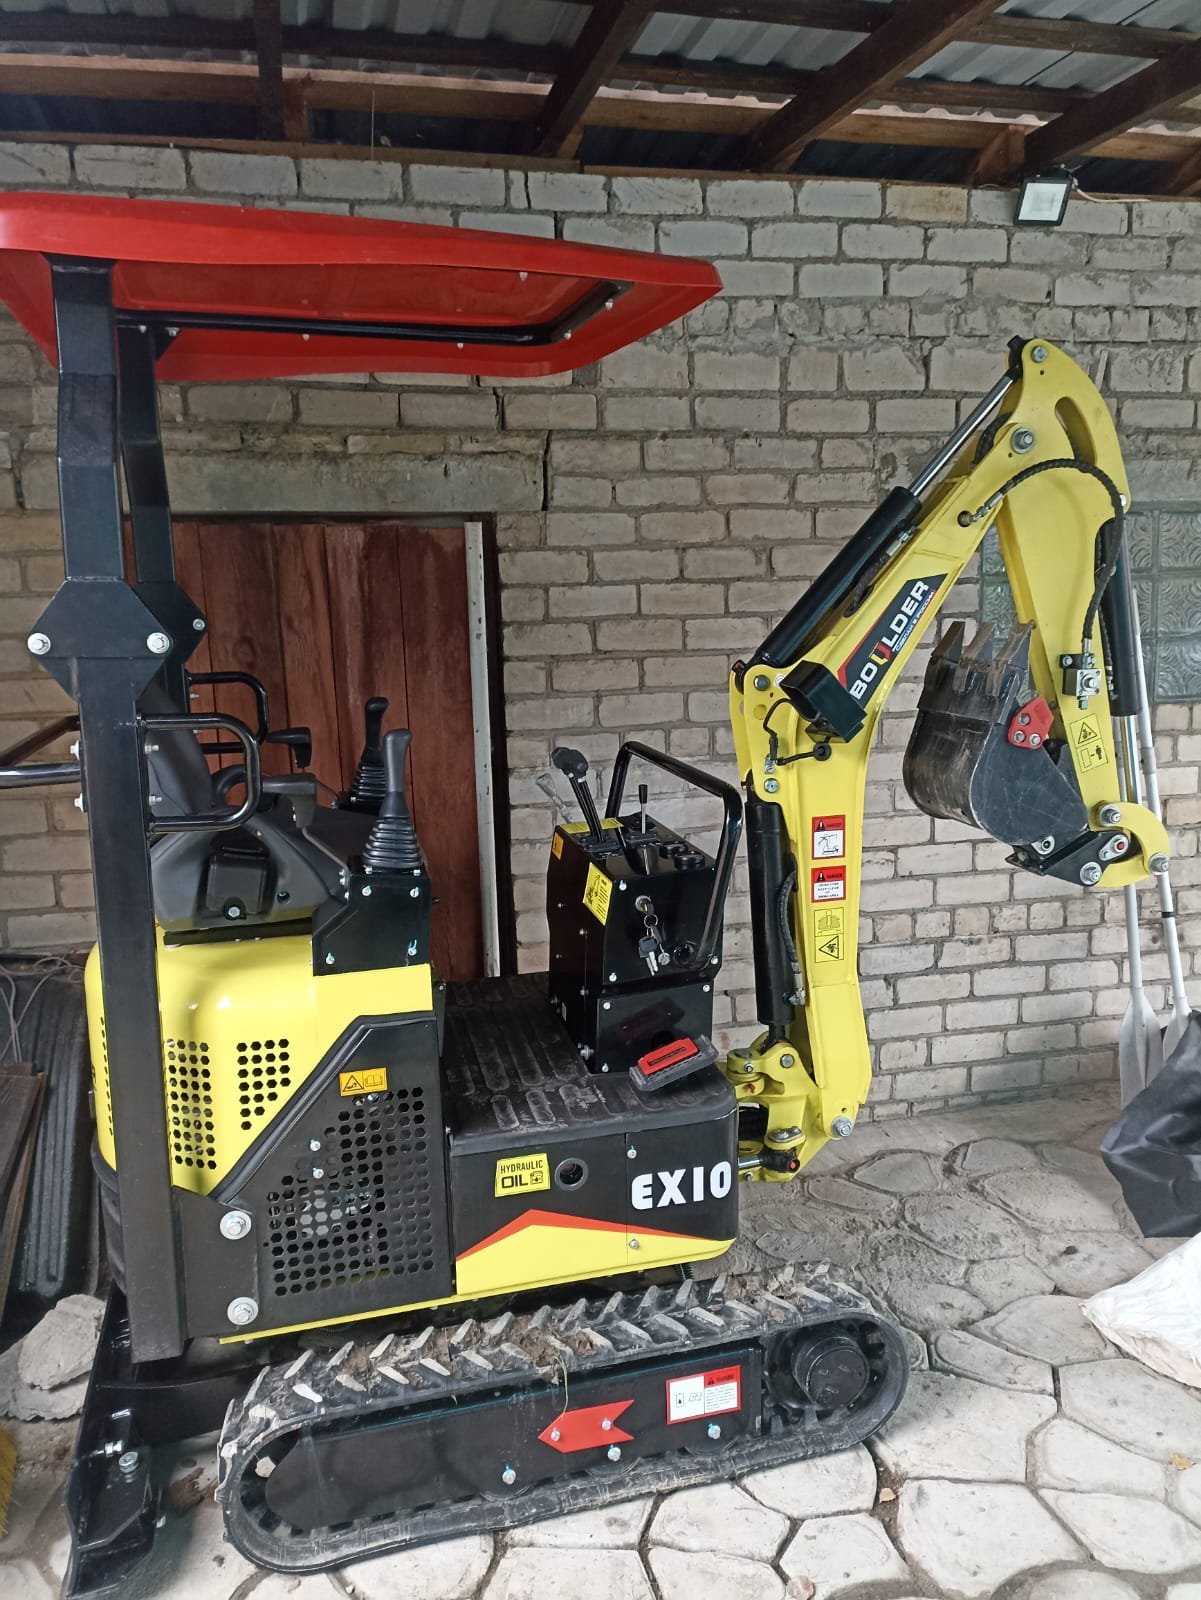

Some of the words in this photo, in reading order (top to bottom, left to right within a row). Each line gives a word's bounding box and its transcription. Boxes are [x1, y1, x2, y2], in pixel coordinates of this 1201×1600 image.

[849, 580, 930, 700] BOULDER
[500, 1160, 543, 1174] HYDRAULIC
[501, 1174, 529, 1189] OIL
[631, 1161, 732, 1210] EX10
